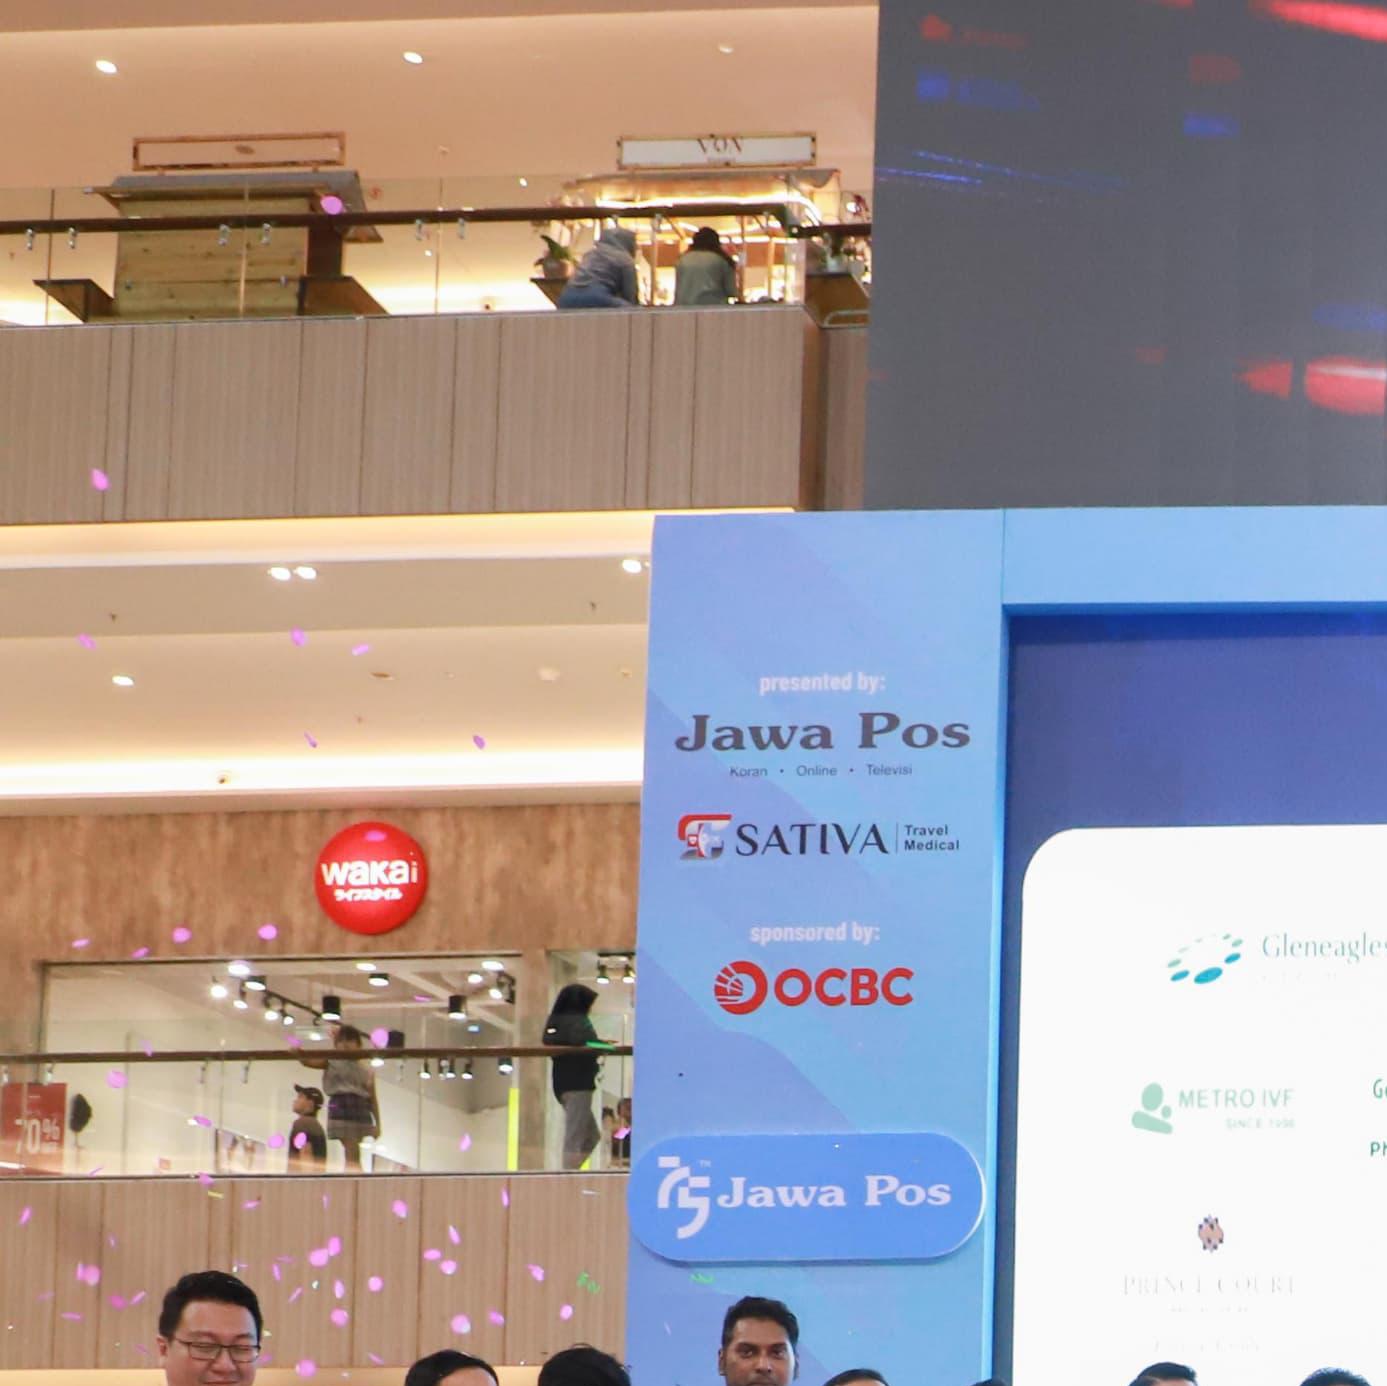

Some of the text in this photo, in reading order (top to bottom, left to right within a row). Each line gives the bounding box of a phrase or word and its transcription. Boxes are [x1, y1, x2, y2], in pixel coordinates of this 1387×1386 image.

[759, 671, 886, 696] presented by:
[675, 712, 970, 752] Jawa Pos
[729, 763, 913, 777] Koran Online Televisi
[735, 823, 889, 856] SATIVA
[904, 825, 948, 837] Travel
[904, 839, 960, 851] Medical
[321, 860, 418, 885] wakai
[750, 922, 880, 945] sponsored by:
[775, 967, 914, 1006] OCBC
[1178, 1088, 1295, 1109] METRO IVF
[717, 1175, 951, 1208] Jawa Pos
